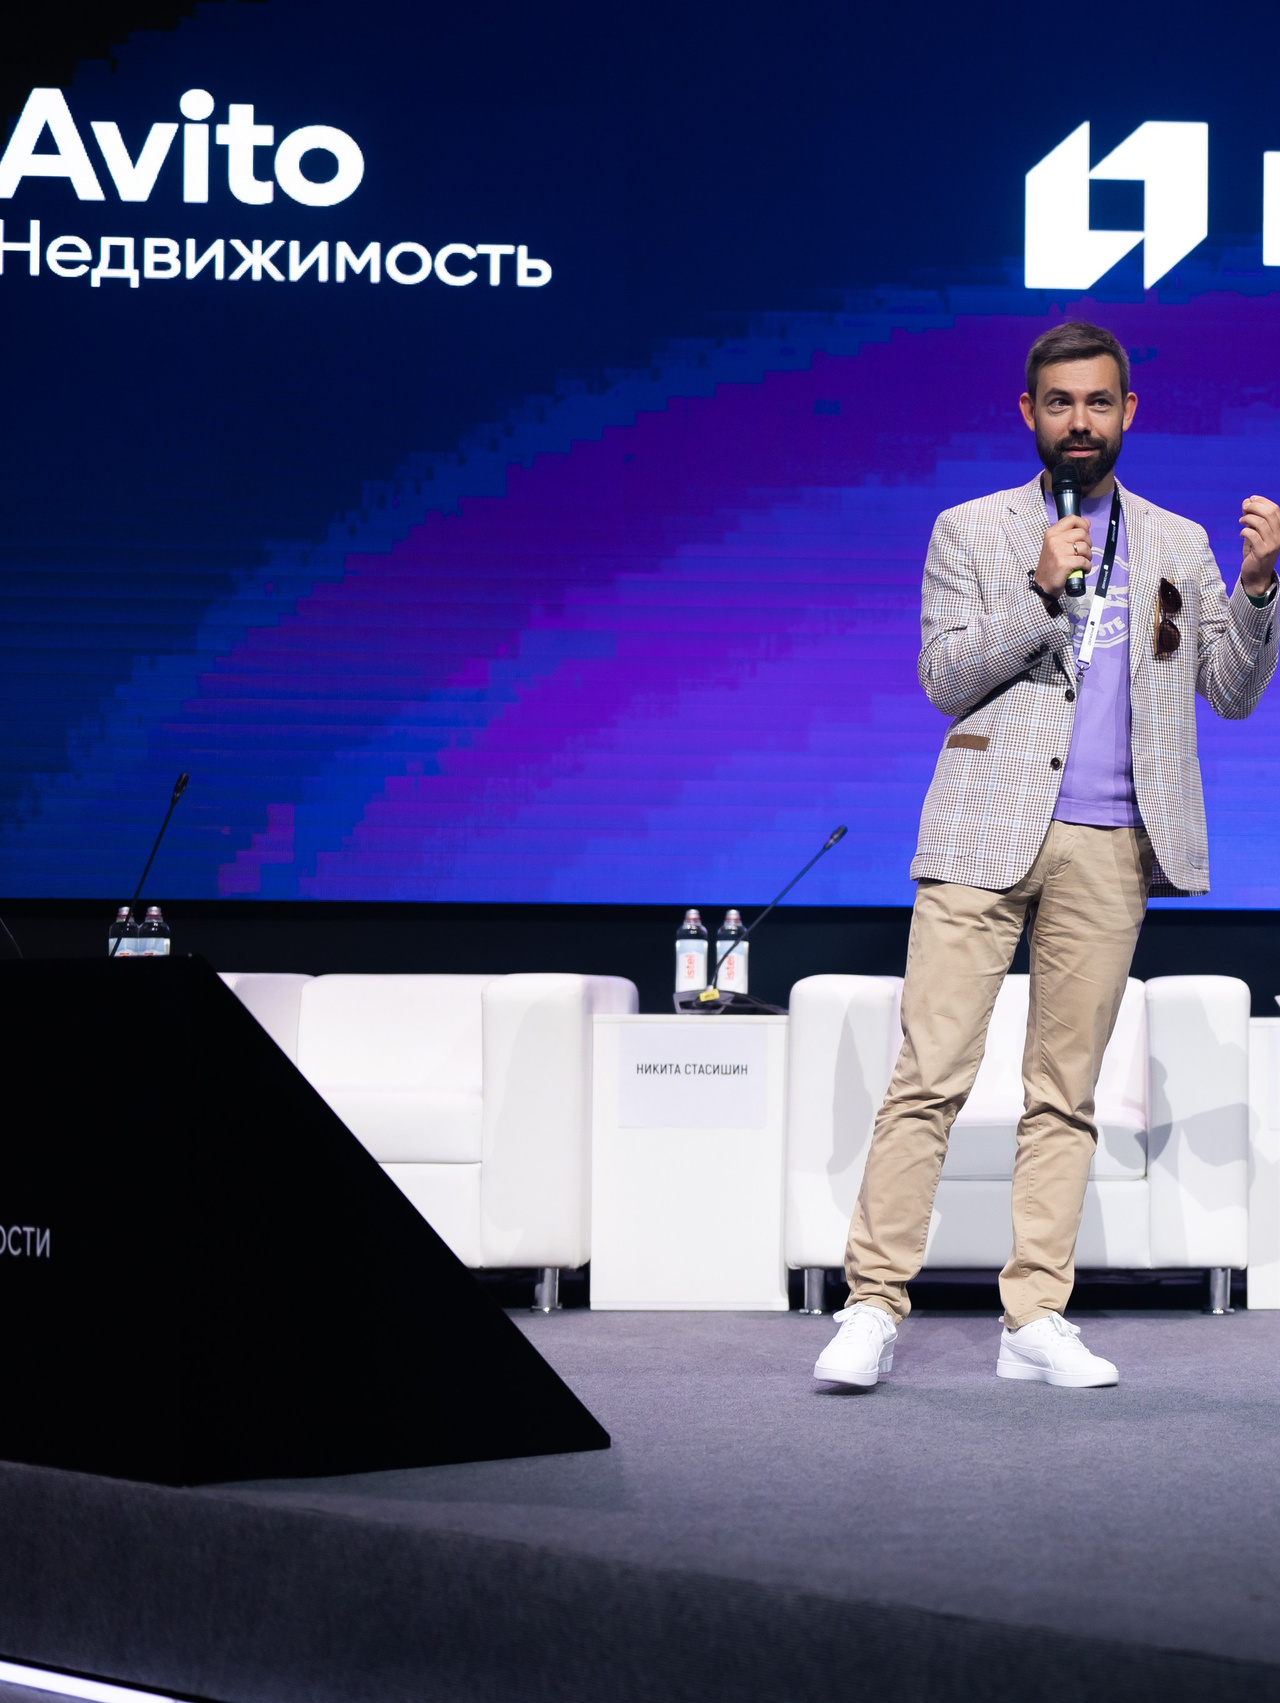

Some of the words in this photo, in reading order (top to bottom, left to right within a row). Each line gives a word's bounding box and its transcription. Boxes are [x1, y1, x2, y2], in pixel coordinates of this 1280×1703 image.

[0, 88, 364, 207] Avito
[0, 219, 552, 288] Недвижимость
[636, 1063, 681, 1075] НИКИТА
[684, 1063, 748, 1075] СТАСИШИН
